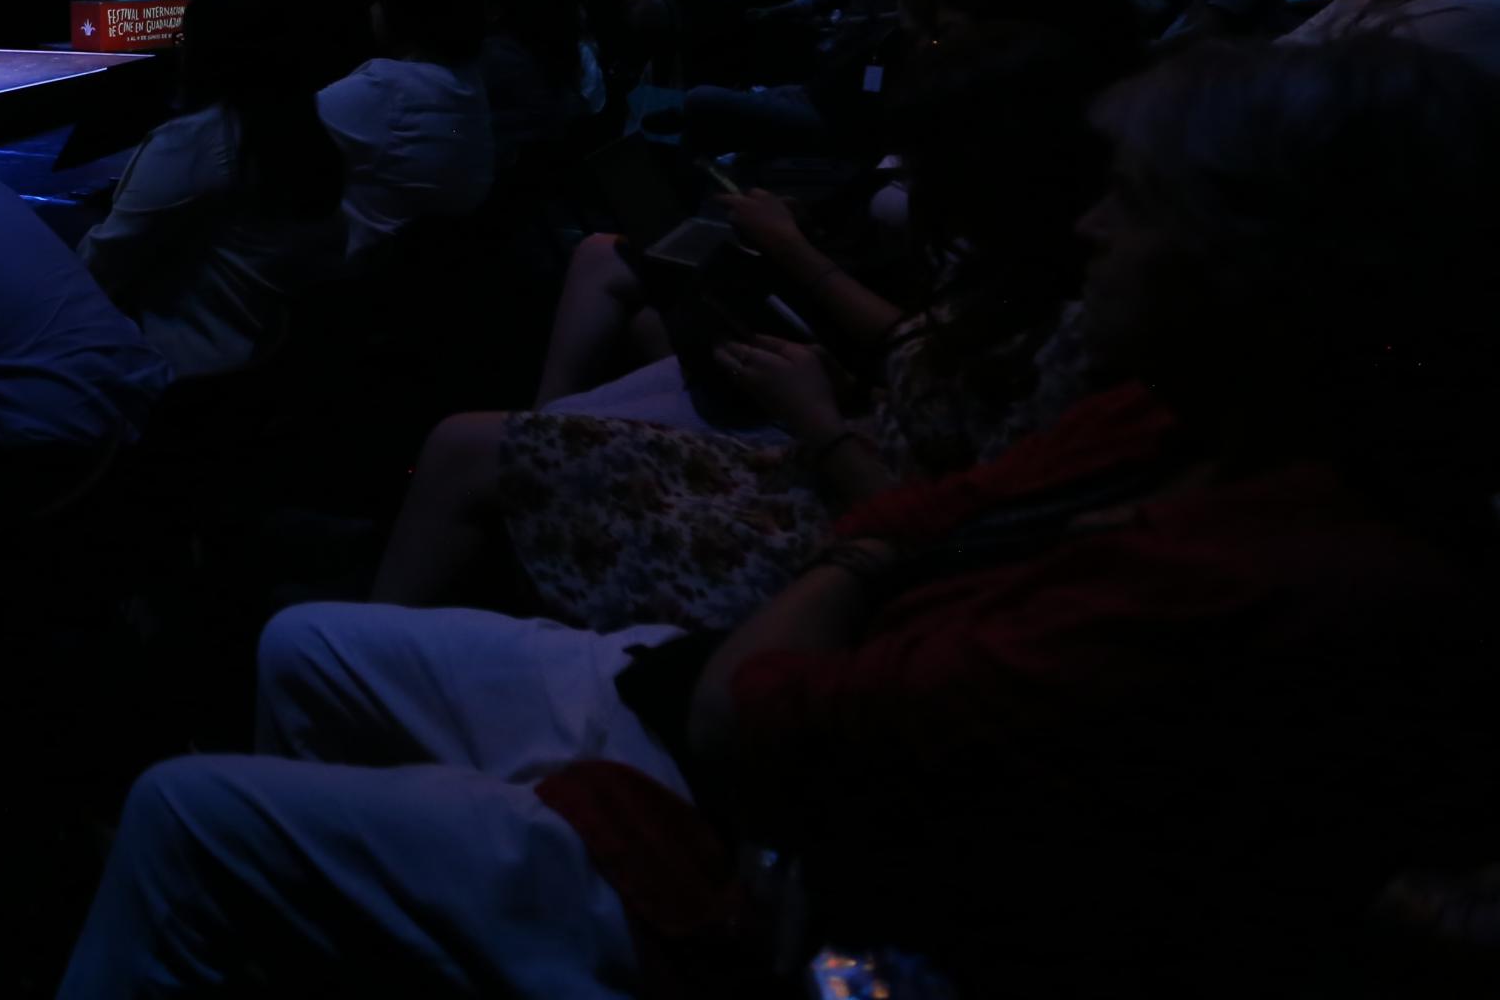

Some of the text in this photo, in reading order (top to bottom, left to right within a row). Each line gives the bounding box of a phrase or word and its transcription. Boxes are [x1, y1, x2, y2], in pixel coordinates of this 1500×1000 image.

[107, 8, 139, 25] FESTIVAL
[108, 25, 117, 37] DE
[118, 21, 133, 36] CINE
[135, 22, 144, 33] EN
